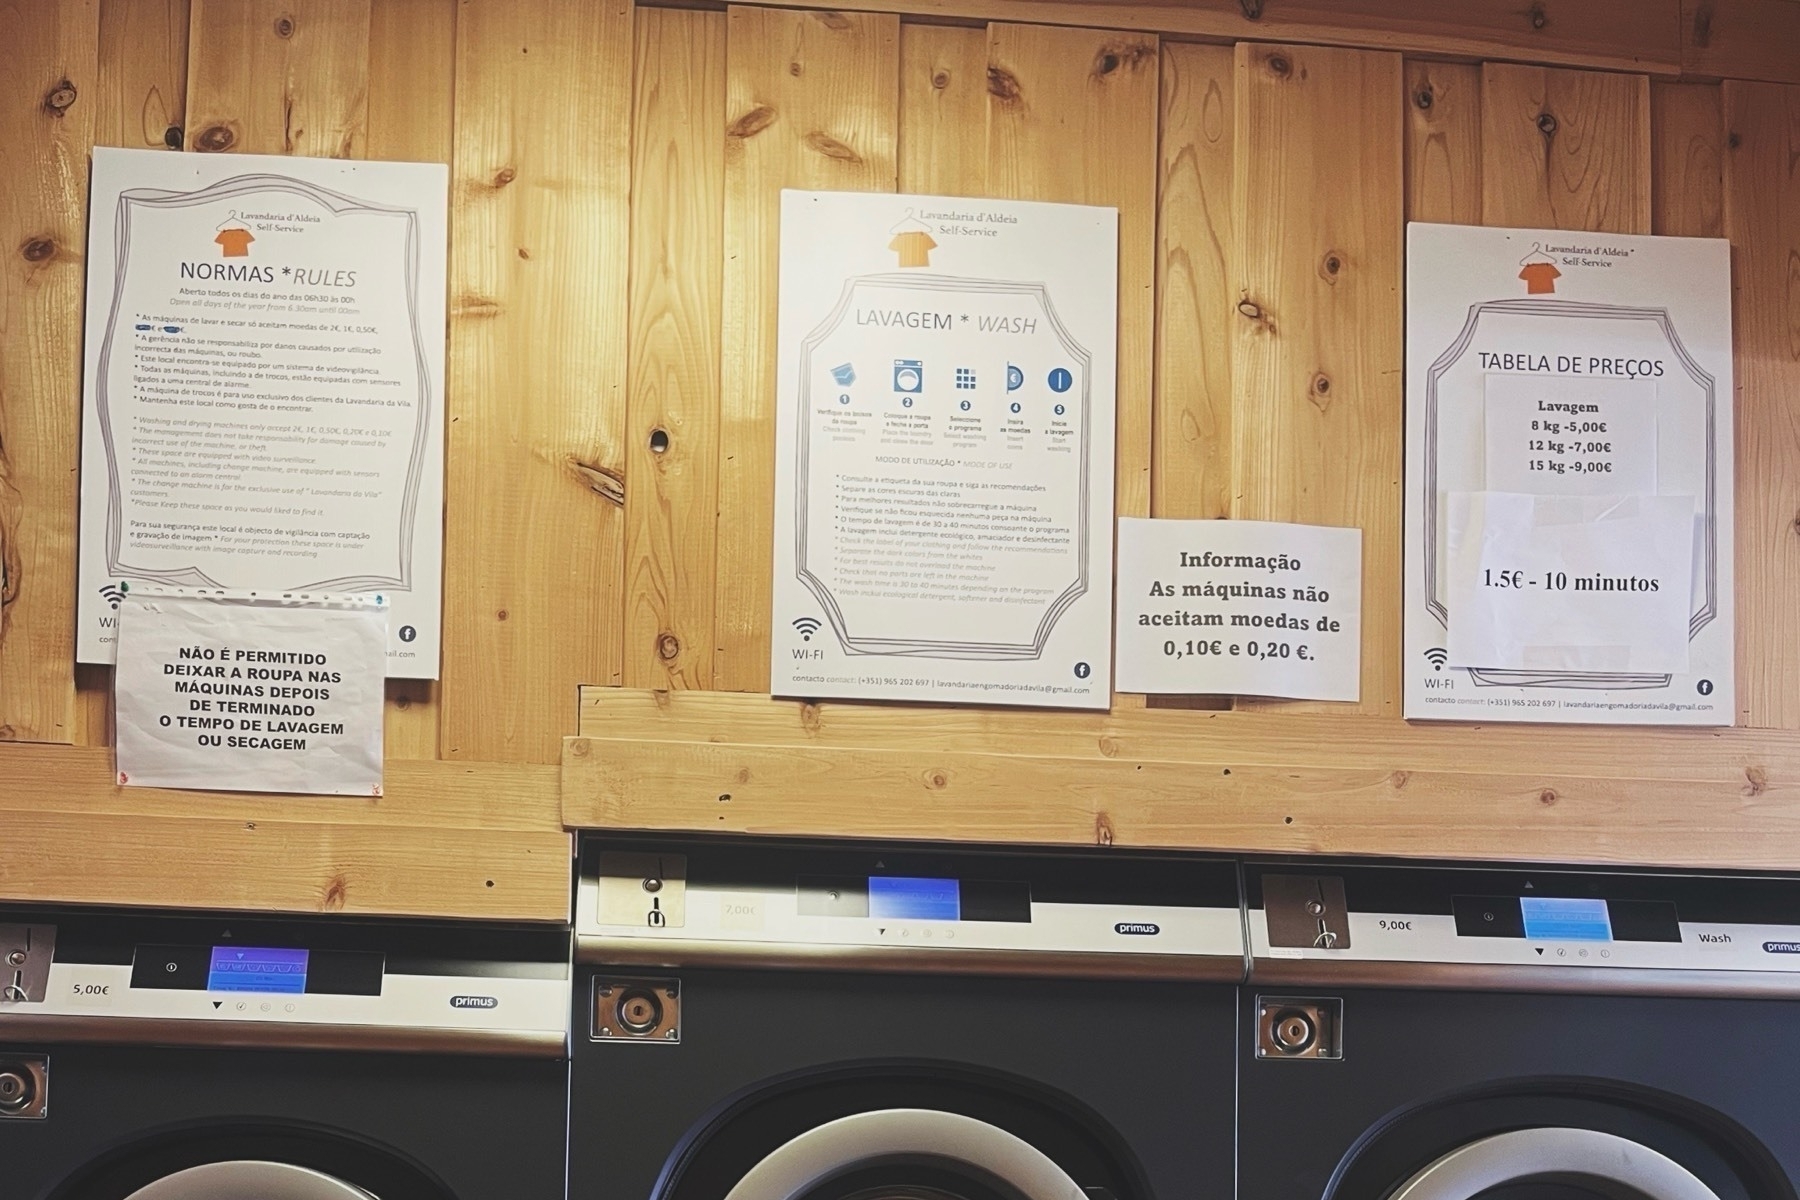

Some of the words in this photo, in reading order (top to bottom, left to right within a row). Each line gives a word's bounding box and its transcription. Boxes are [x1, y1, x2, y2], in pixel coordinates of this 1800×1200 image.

[240, 212, 285, 222] Lavandaria
[287, 213, 321, 224] d'Aldeia
[919, 209, 974, 222] Lavandaria
[976, 212, 1018, 224] d'Aldeia
[256, 222, 304, 233] Self-Service
[939, 225, 998, 237] Self-Service
[1545, 244, 1593, 255] Lavandaria
[1594, 246, 1629, 257] d'Aldeia
[1562, 256, 1612, 268] Self-Service
[180, 261, 274, 283] NORMAS
[178, 287, 207, 296] Aberto
[207, 289, 231, 298] todos
[242, 290, 259, 299] dias
[259, 291, 271, 300] do
[272, 293, 288, 301] ano
[288, 293, 303, 302] das
[303, 294, 329, 303] 06h30
[329, 295, 339, 303] às
[340, 296, 356, 304] 00h
[856, 308, 952, 331] LAVAGEM
[978, 315, 1037, 335] WASH
[1477, 351, 1551, 372] TABELA
[1557, 355, 1582, 374] DE
[1589, 357, 1664, 380] PREÇOS
[139, 395, 178, 405] Mantenha
[196, 399, 214, 407] local
[214, 401, 236, 409] como
[1537, 400, 1599, 416] Lavagem
[1531, 420, 1539, 431] 8
[1543, 420, 1560, 435] kg
[1529, 439, 1544, 451] 12
[1547, 440, 1565, 455] kg
[874, 455, 900, 464] MODO
[900, 456, 911, 465] DE
[912, 457, 956, 470] UTILIZAÇÃO
[962, 460, 986, 468] MODE
[987, 461, 998, 469] OF
[998, 462, 1013, 470] USE
[1529, 459, 1544, 471] 15
[1548, 459, 1565, 475] kg
[848, 516, 873, 525] tempo
[873, 517, 883, 525] de
[884, 517, 914, 527] lavagem
[921, 520, 931, 528] de
[932, 520, 943, 528] 30
[948, 521, 959, 529] 40
[959, 522, 989, 530] minutos
[990, 524, 1028, 533] consoante
[1035, 526, 1070, 535] programa
[1179, 551, 1301, 574] Informação
[1484, 568, 1524, 589] 1.5€
[1545, 571, 1567, 591] 10
[1574, 572, 1659, 592] minutos
[1148, 580, 1176, 597] As
[1181, 580, 1286, 601] máquinas
[1292, 585, 1330, 603] não
[1138, 610, 1224, 627] aceitam
[1230, 612, 1310, 631] moedas
[1316, 615, 1340, 633] de
[179, 645, 215, 661] NÃO
[220, 646, 230, 661] É
[235, 649, 327, 666] PERMITIDO
[791, 648, 824, 661] WI-FI
[1163, 639, 1222, 660] 0,10€
[1228, 643, 1240, 656] e
[1246, 640, 1290, 661] 0,20
[1296, 644, 1315, 661] €.
[163, 664, 226, 678] DEIXAR
[230, 666, 242, 679] A
[247, 667, 303, 682] ROUPA
[308, 671, 342, 683] NAS
[174, 679, 265, 697] MÁQUINAS
[269, 686, 330, 701] DEPOIS
[1423, 677, 1454, 690] WI-FI
[189, 698, 212, 712] DE
[216, 700, 315, 717] TERMINADO
[159, 714, 172, 727] O
[176, 715, 235, 730] TEMPO
[239, 719, 262, 732] DE
[267, 720, 344, 735] LAVAGEM
[197, 734, 222, 747] OU
[226, 735, 306, 750] SECAGEM
[1120, 923, 1156, 933] primus
[1378, 919, 1412, 931] 9,00€
[1698, 932, 1732, 943] Wash
[71, 983, 109, 996] 5,00€
[455, 996, 494, 1007] primus
